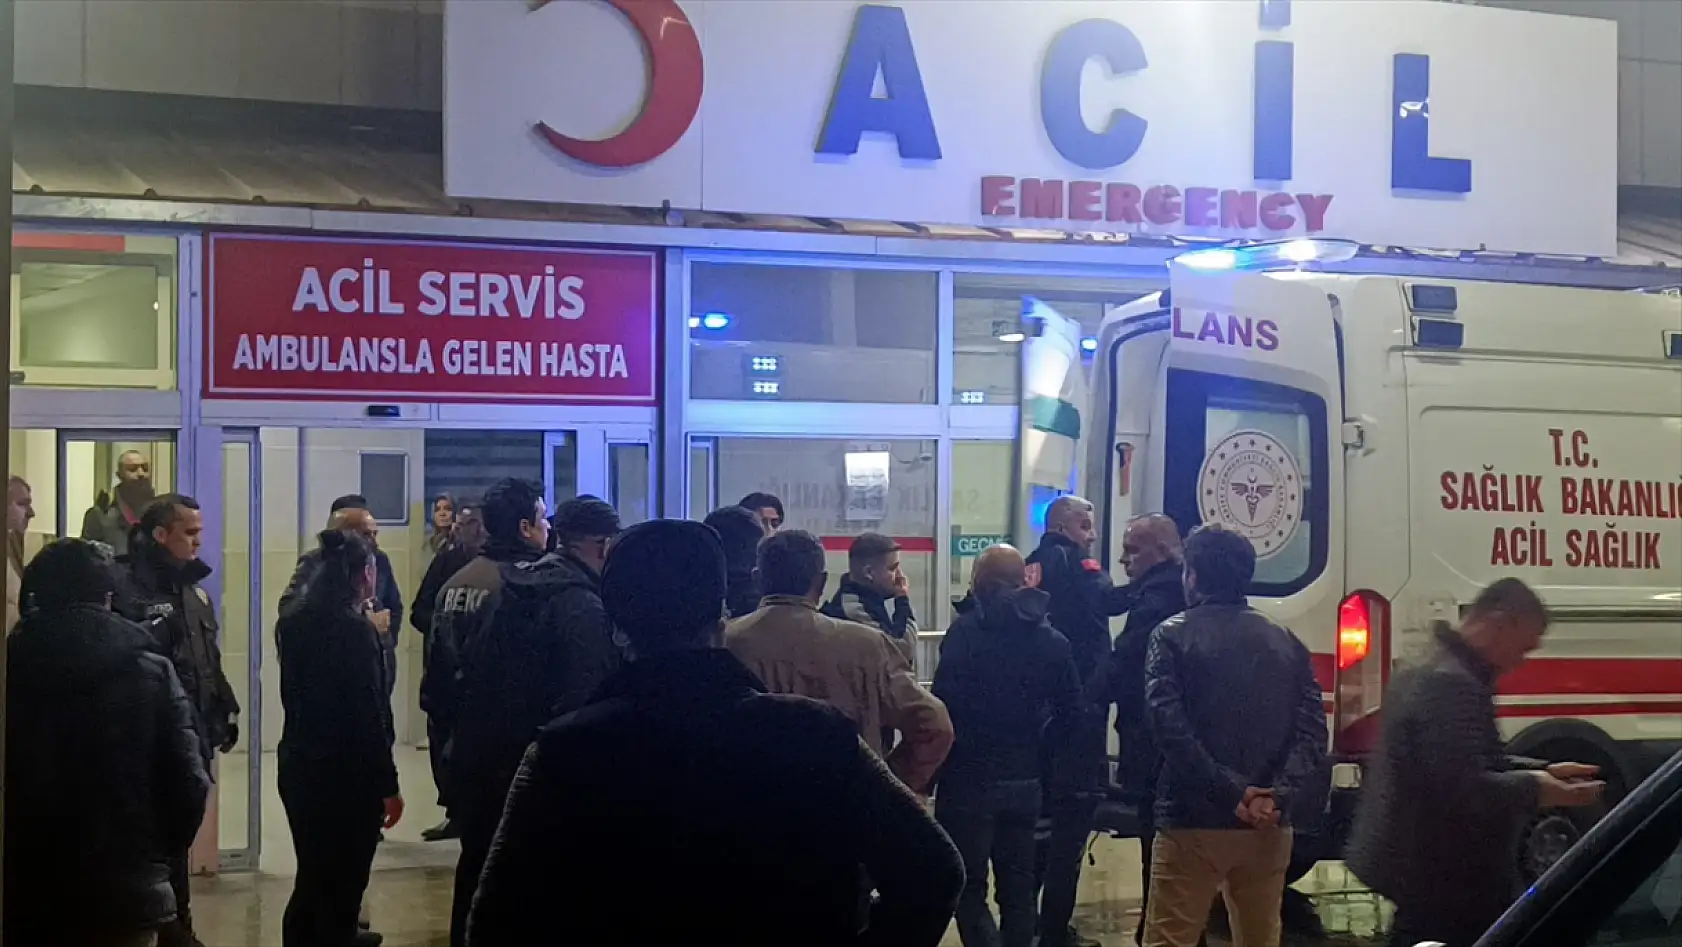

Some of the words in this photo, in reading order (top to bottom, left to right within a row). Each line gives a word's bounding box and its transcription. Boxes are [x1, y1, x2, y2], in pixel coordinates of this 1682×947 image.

[814, 0, 1473, 193] ACİL
[981, 175, 1334, 233] EMERGENCY
[292, 257, 405, 314] ACİL
[417, 265, 586, 320] SERVİS
[1173, 306, 1279, 351] LANS
[232, 333, 435, 375] AMBULANSLA
[442, 339, 532, 376] GELEN
[539, 342, 628, 378] HASTA
[1548, 428, 1599, 468] T.C.
[1440, 463, 1544, 513] SAĞLIK
[1561, 474, 1682, 519] BAKANLI
[1491, 520, 1553, 567] ACİL
[1565, 521, 1661, 569] SAĞLIK
